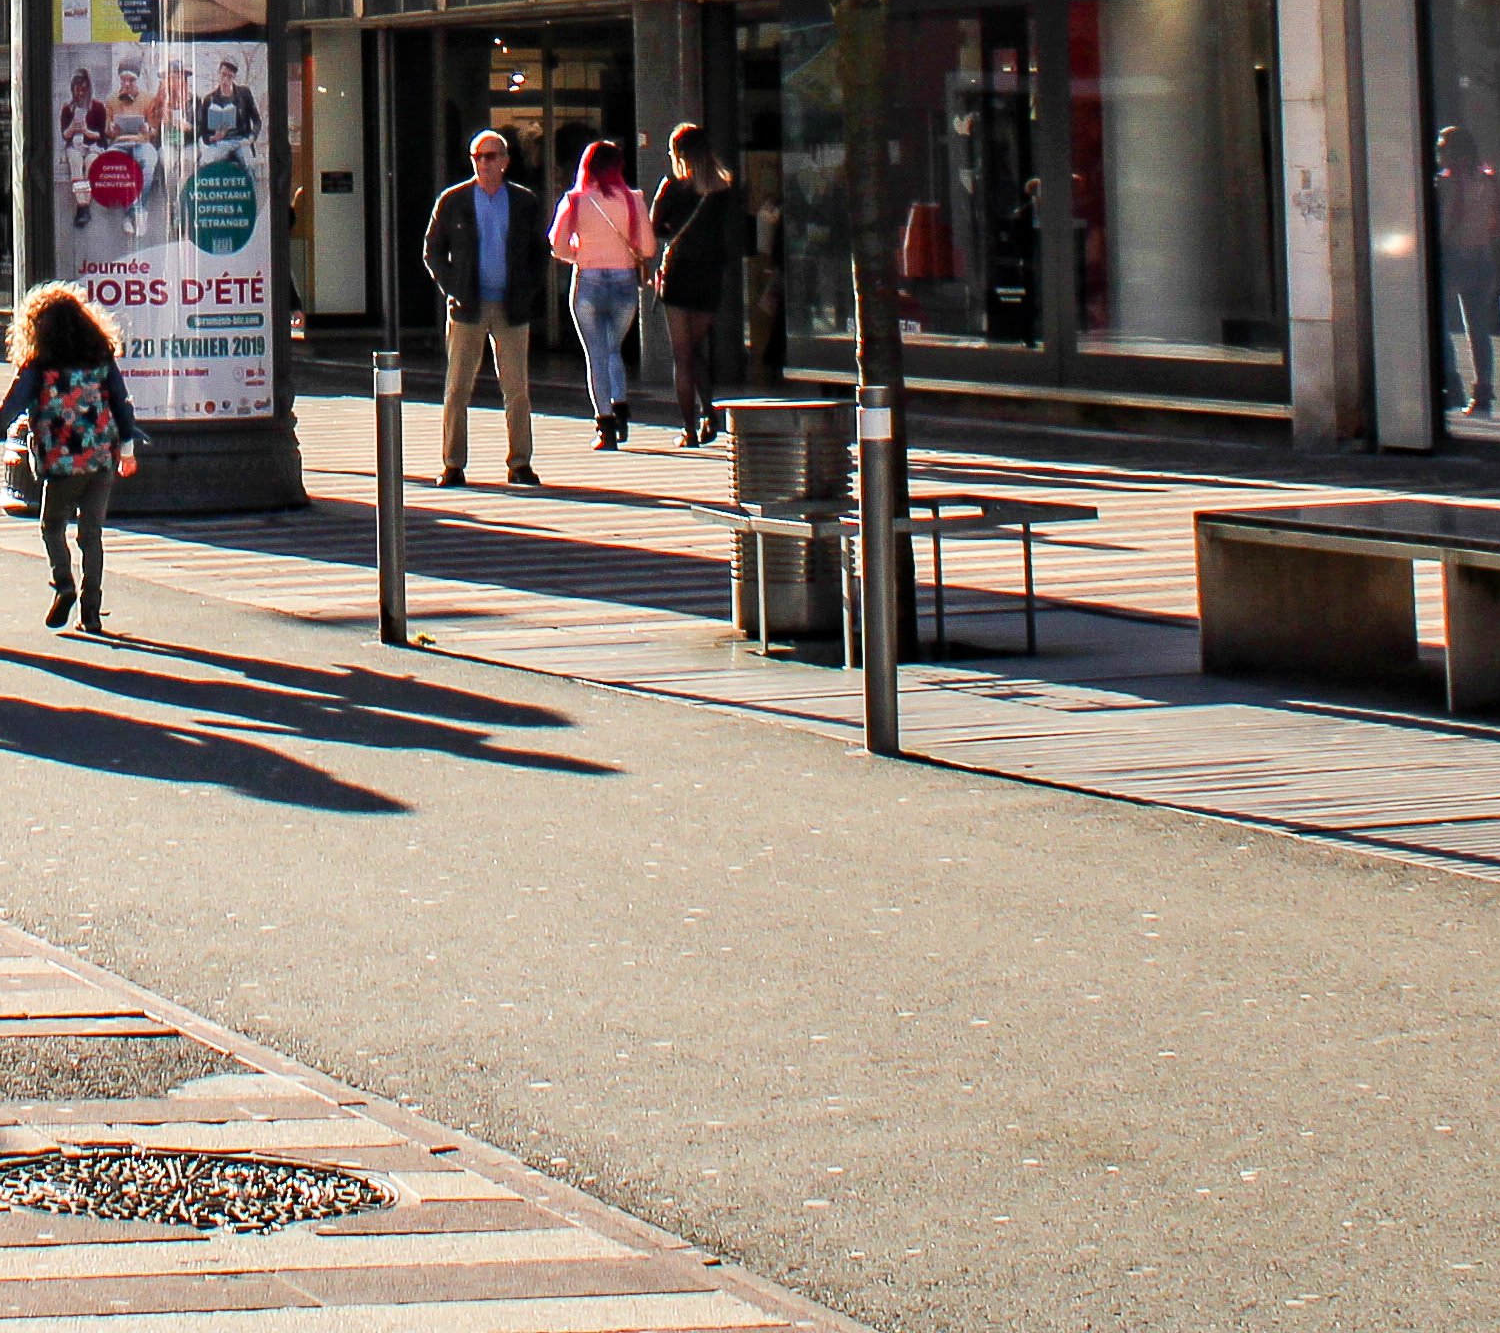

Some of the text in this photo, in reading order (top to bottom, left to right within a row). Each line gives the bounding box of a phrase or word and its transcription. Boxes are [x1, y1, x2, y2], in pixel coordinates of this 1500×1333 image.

[199, 205, 235, 214] OFFRES
[78, 258, 151, 275] Journée
[181, 270, 265, 305] D'ÉTÉ
[161, 334, 229, 358] FÉVRIER
[232, 336, 266, 357] 2019
